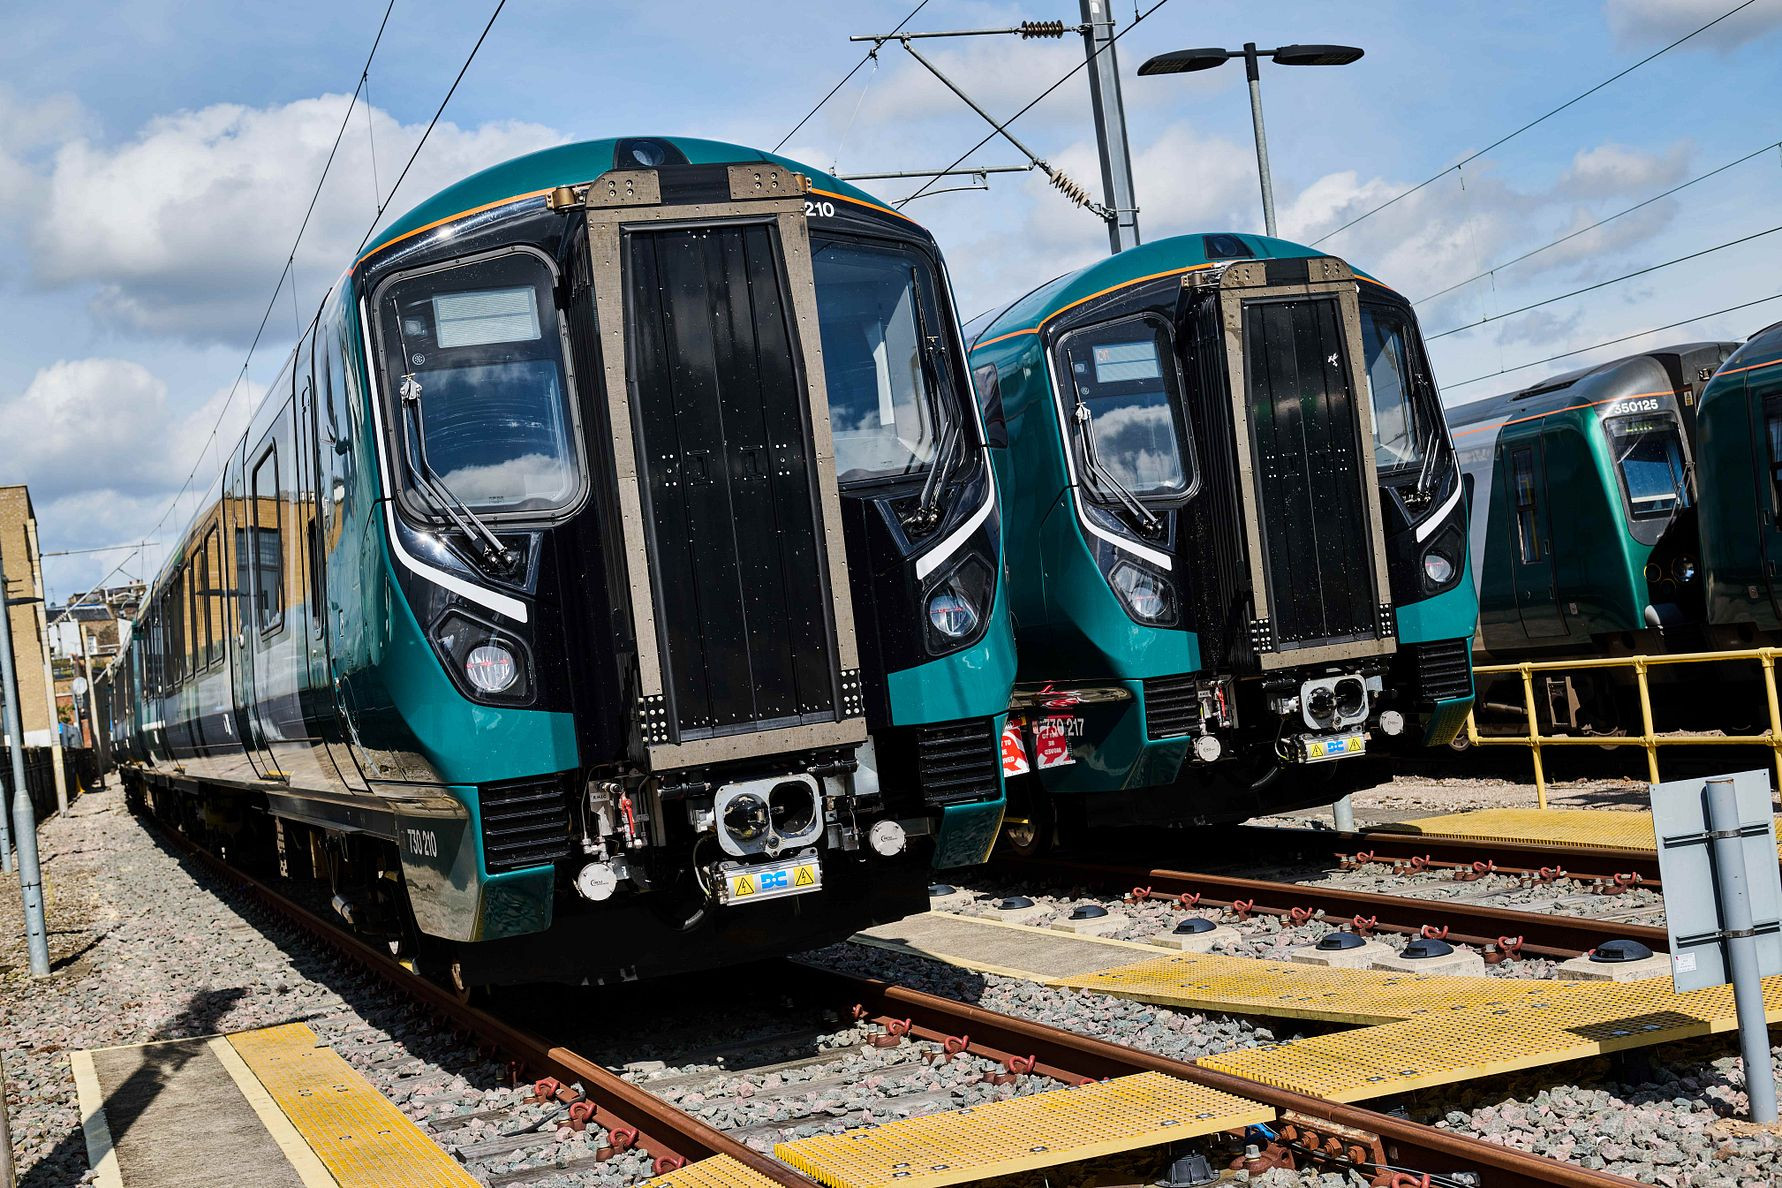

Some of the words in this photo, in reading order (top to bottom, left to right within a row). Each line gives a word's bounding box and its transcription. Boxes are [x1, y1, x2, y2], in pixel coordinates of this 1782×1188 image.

[804, 201, 835, 218] 210
[1614, 399, 1659, 414] 350125
[1044, 718, 1064, 737] 730
[1066, 718, 1084, 737] 217
[407, 829, 423, 855] 730
[423, 830, 438, 858] 210
